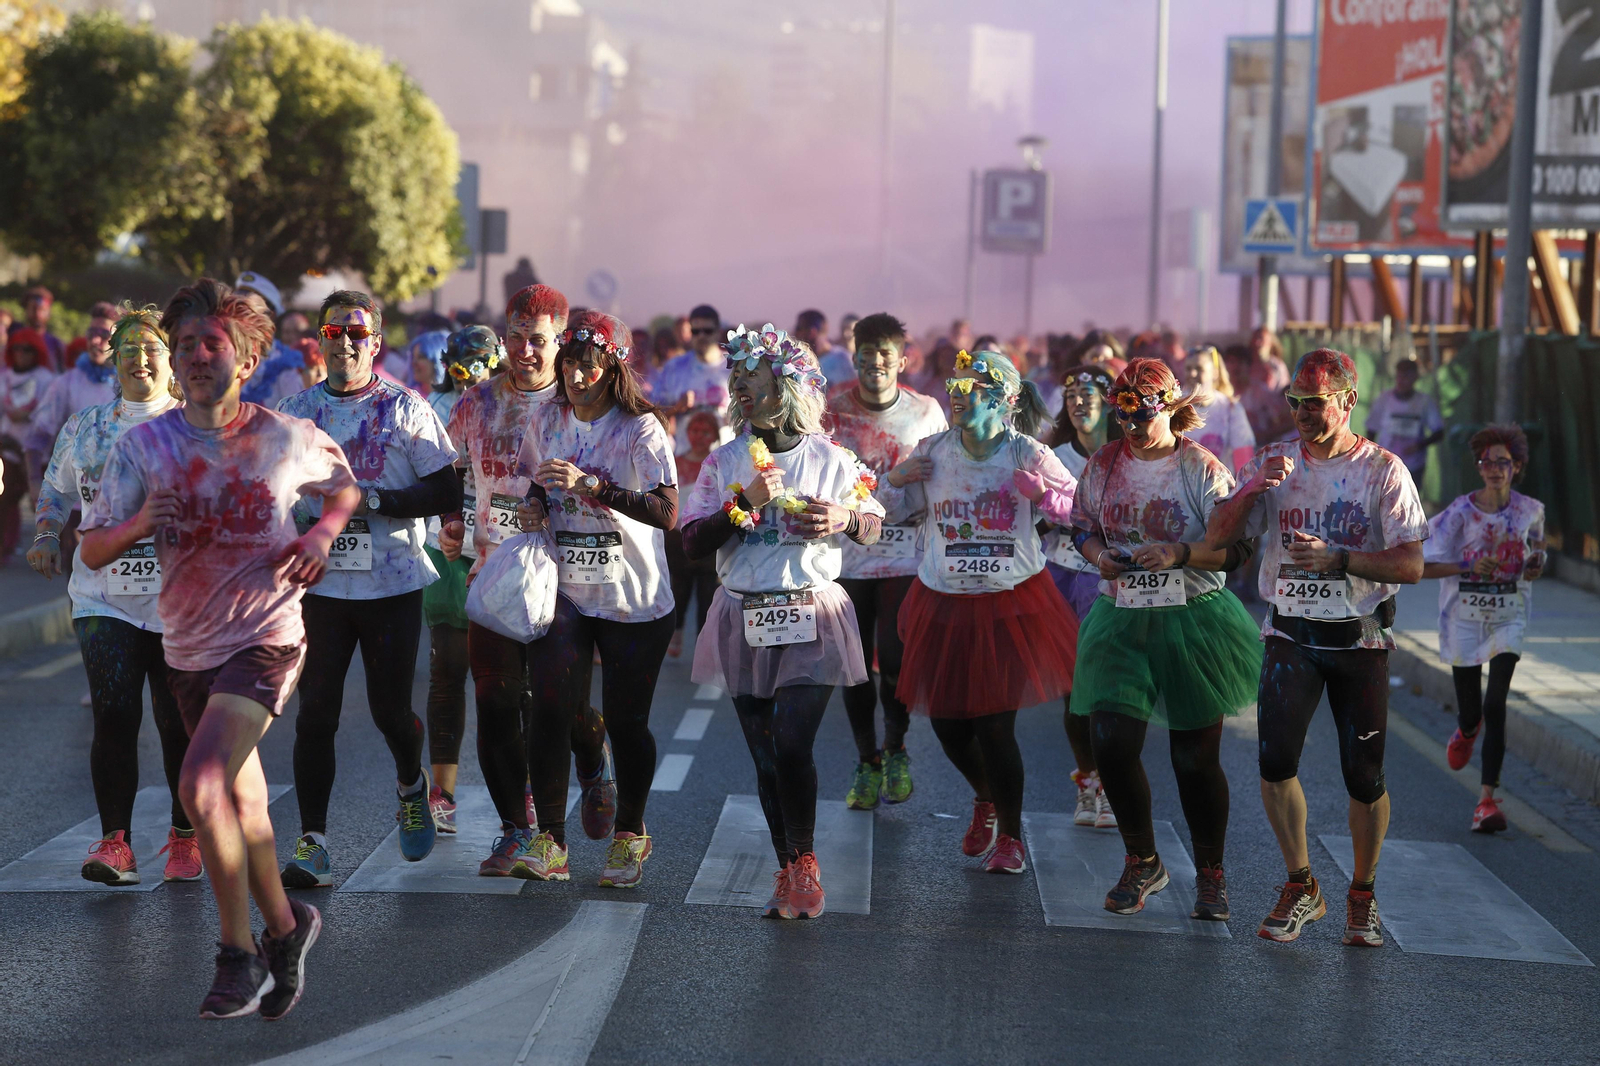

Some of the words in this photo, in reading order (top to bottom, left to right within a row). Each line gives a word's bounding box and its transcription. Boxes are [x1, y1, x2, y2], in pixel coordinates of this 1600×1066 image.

[1331, 0, 1450, 28] Conforam
[999, 179, 1034, 218] P
[934, 499, 970, 521] HOLI
[1103, 503, 1140, 528] HOLI
[1279, 508, 1321, 532] HOLI
[1329, 509, 1364, 535] Life
[566, 549, 609, 566] 2478
[956, 559, 1001, 573] 2486
[1127, 573, 1169, 589] 2487
[1285, 582, 1331, 598] 2496
[1469, 594, 1506, 608] 2641
[755, 608, 801, 627] 2495
